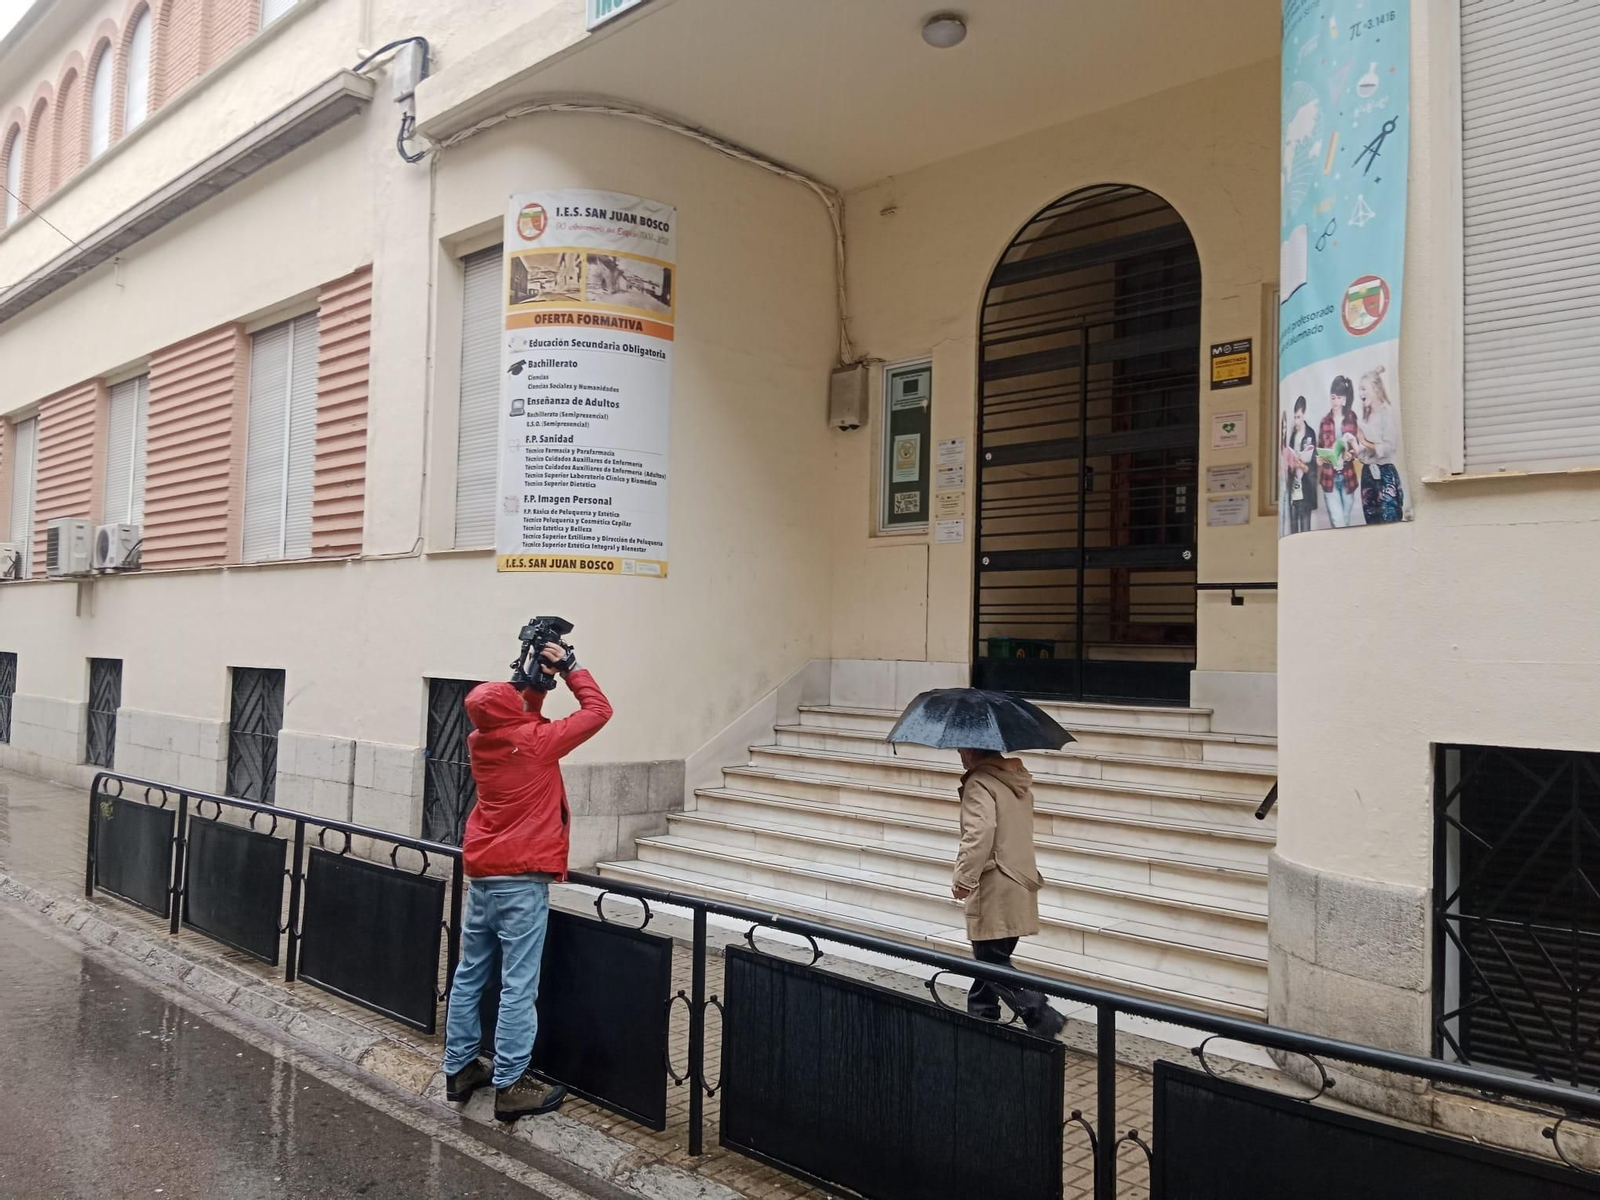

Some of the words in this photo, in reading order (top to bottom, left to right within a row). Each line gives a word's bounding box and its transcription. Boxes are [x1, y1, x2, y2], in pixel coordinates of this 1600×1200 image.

[556, 207, 582, 217] I.E.S.
[585, 208, 606, 219] SAN
[609, 211, 637, 224] JUAN
[640, 216, 669, 232] BOSCO
[534, 314, 574, 325] OFERTA
[577, 314, 643, 331] FORMATIVA
[529, 338, 569, 348] Educación
[571, 338, 620, 351] Secundaria
[622, 343, 666, 360] Obligatoria
[528, 359, 578, 368] Bachillerato
[578, 384, 619, 393] Humanidades
[527, 396, 570, 405] Enseñanza
[572, 397, 583, 405] de
[585, 398, 620, 408] Adultos
[559, 411, 609, 420] (Semipresencial)
[525, 435, 538, 443] F.P.
[539, 434, 574, 443] Sanidad
[576, 448, 615, 456] Parafarmacia
[572, 456, 603, 464] Auxiliares
[524, 495, 536, 503] F.P.
[538, 495, 570, 505] Imagen
[573, 495, 612, 506] Personal
[542, 533, 567, 541] Superior
[542, 541, 567, 549] Superior
[592, 543, 616, 551] Integral
[621, 545, 647, 553] Bienestar
[506, 558, 527, 568] I.E.S.
[528, 558, 547, 568] SAN
[549, 559, 577, 569] JUAN
[580, 560, 614, 571] BOSCO
